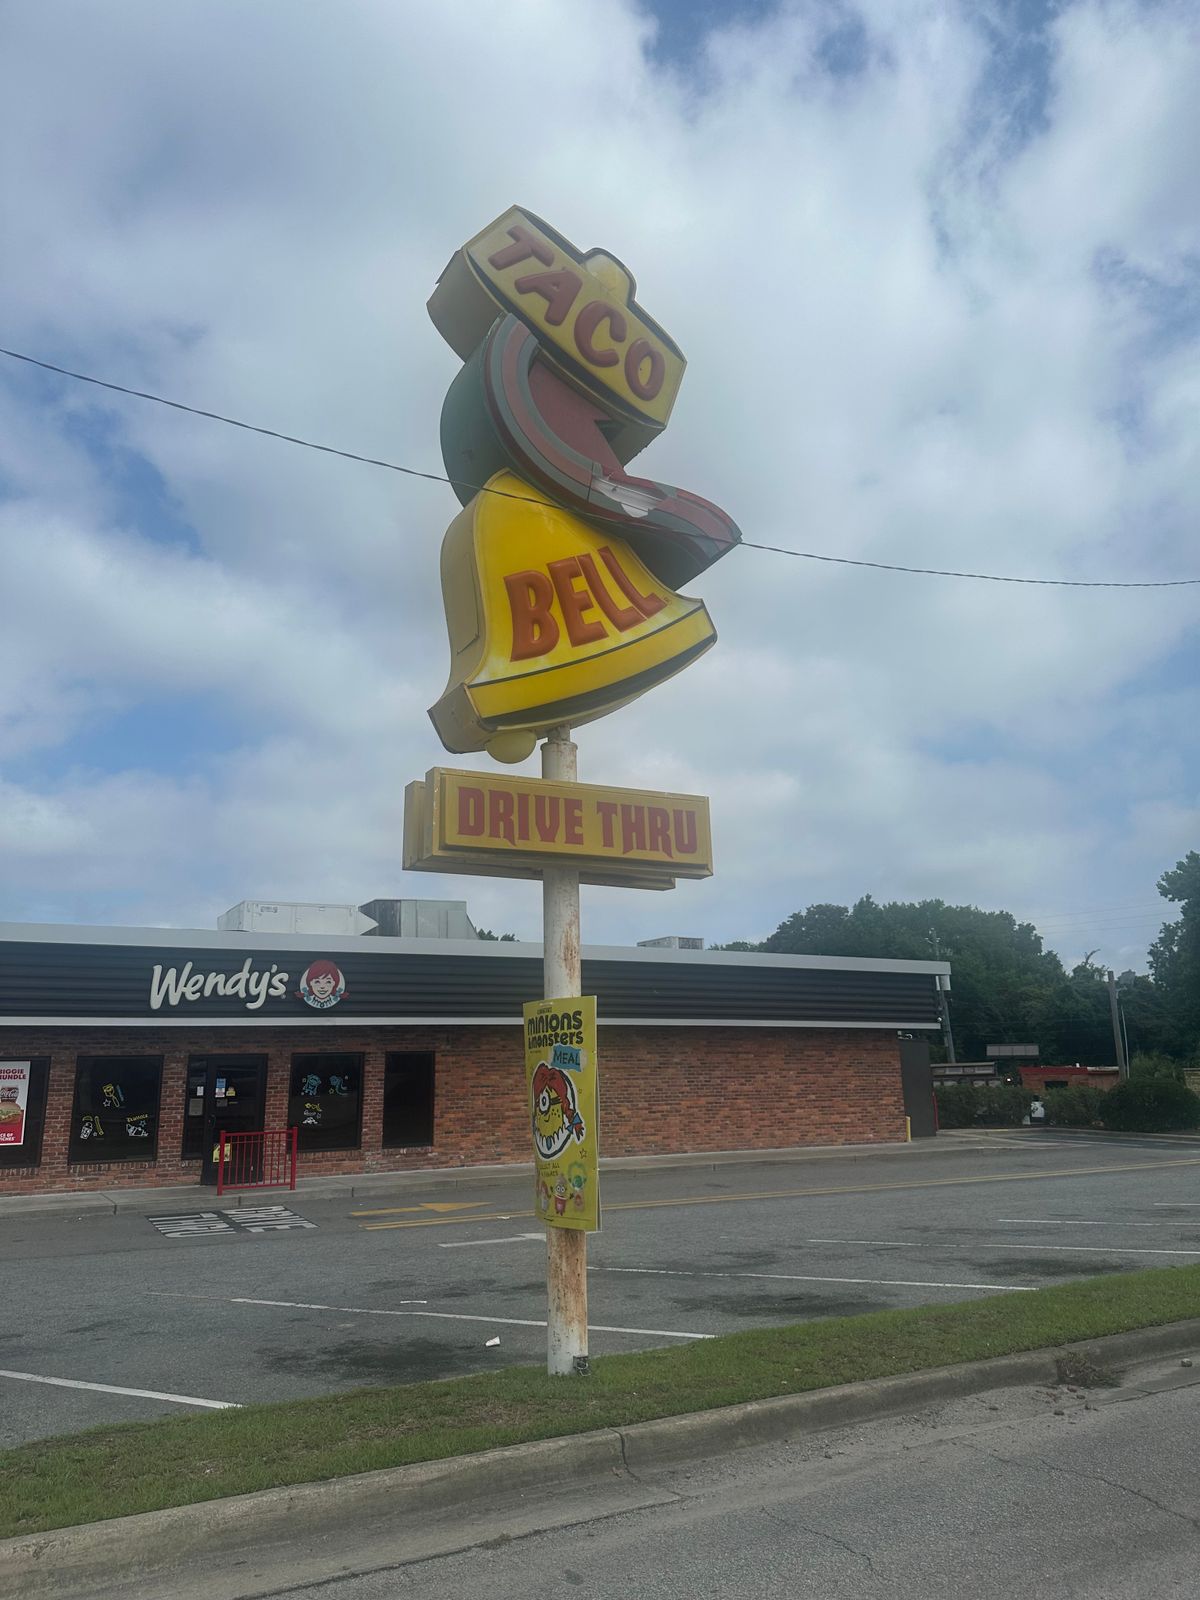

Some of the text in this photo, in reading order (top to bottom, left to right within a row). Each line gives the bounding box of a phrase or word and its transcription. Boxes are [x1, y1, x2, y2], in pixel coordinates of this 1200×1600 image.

[488, 225, 666, 401] TACO
[503, 546, 667, 662] BELL
[457, 786, 698, 859] DRIVE THRU
[150, 957, 289, 1010] Wendy's
[553, 1050, 580, 1066] MEAL
